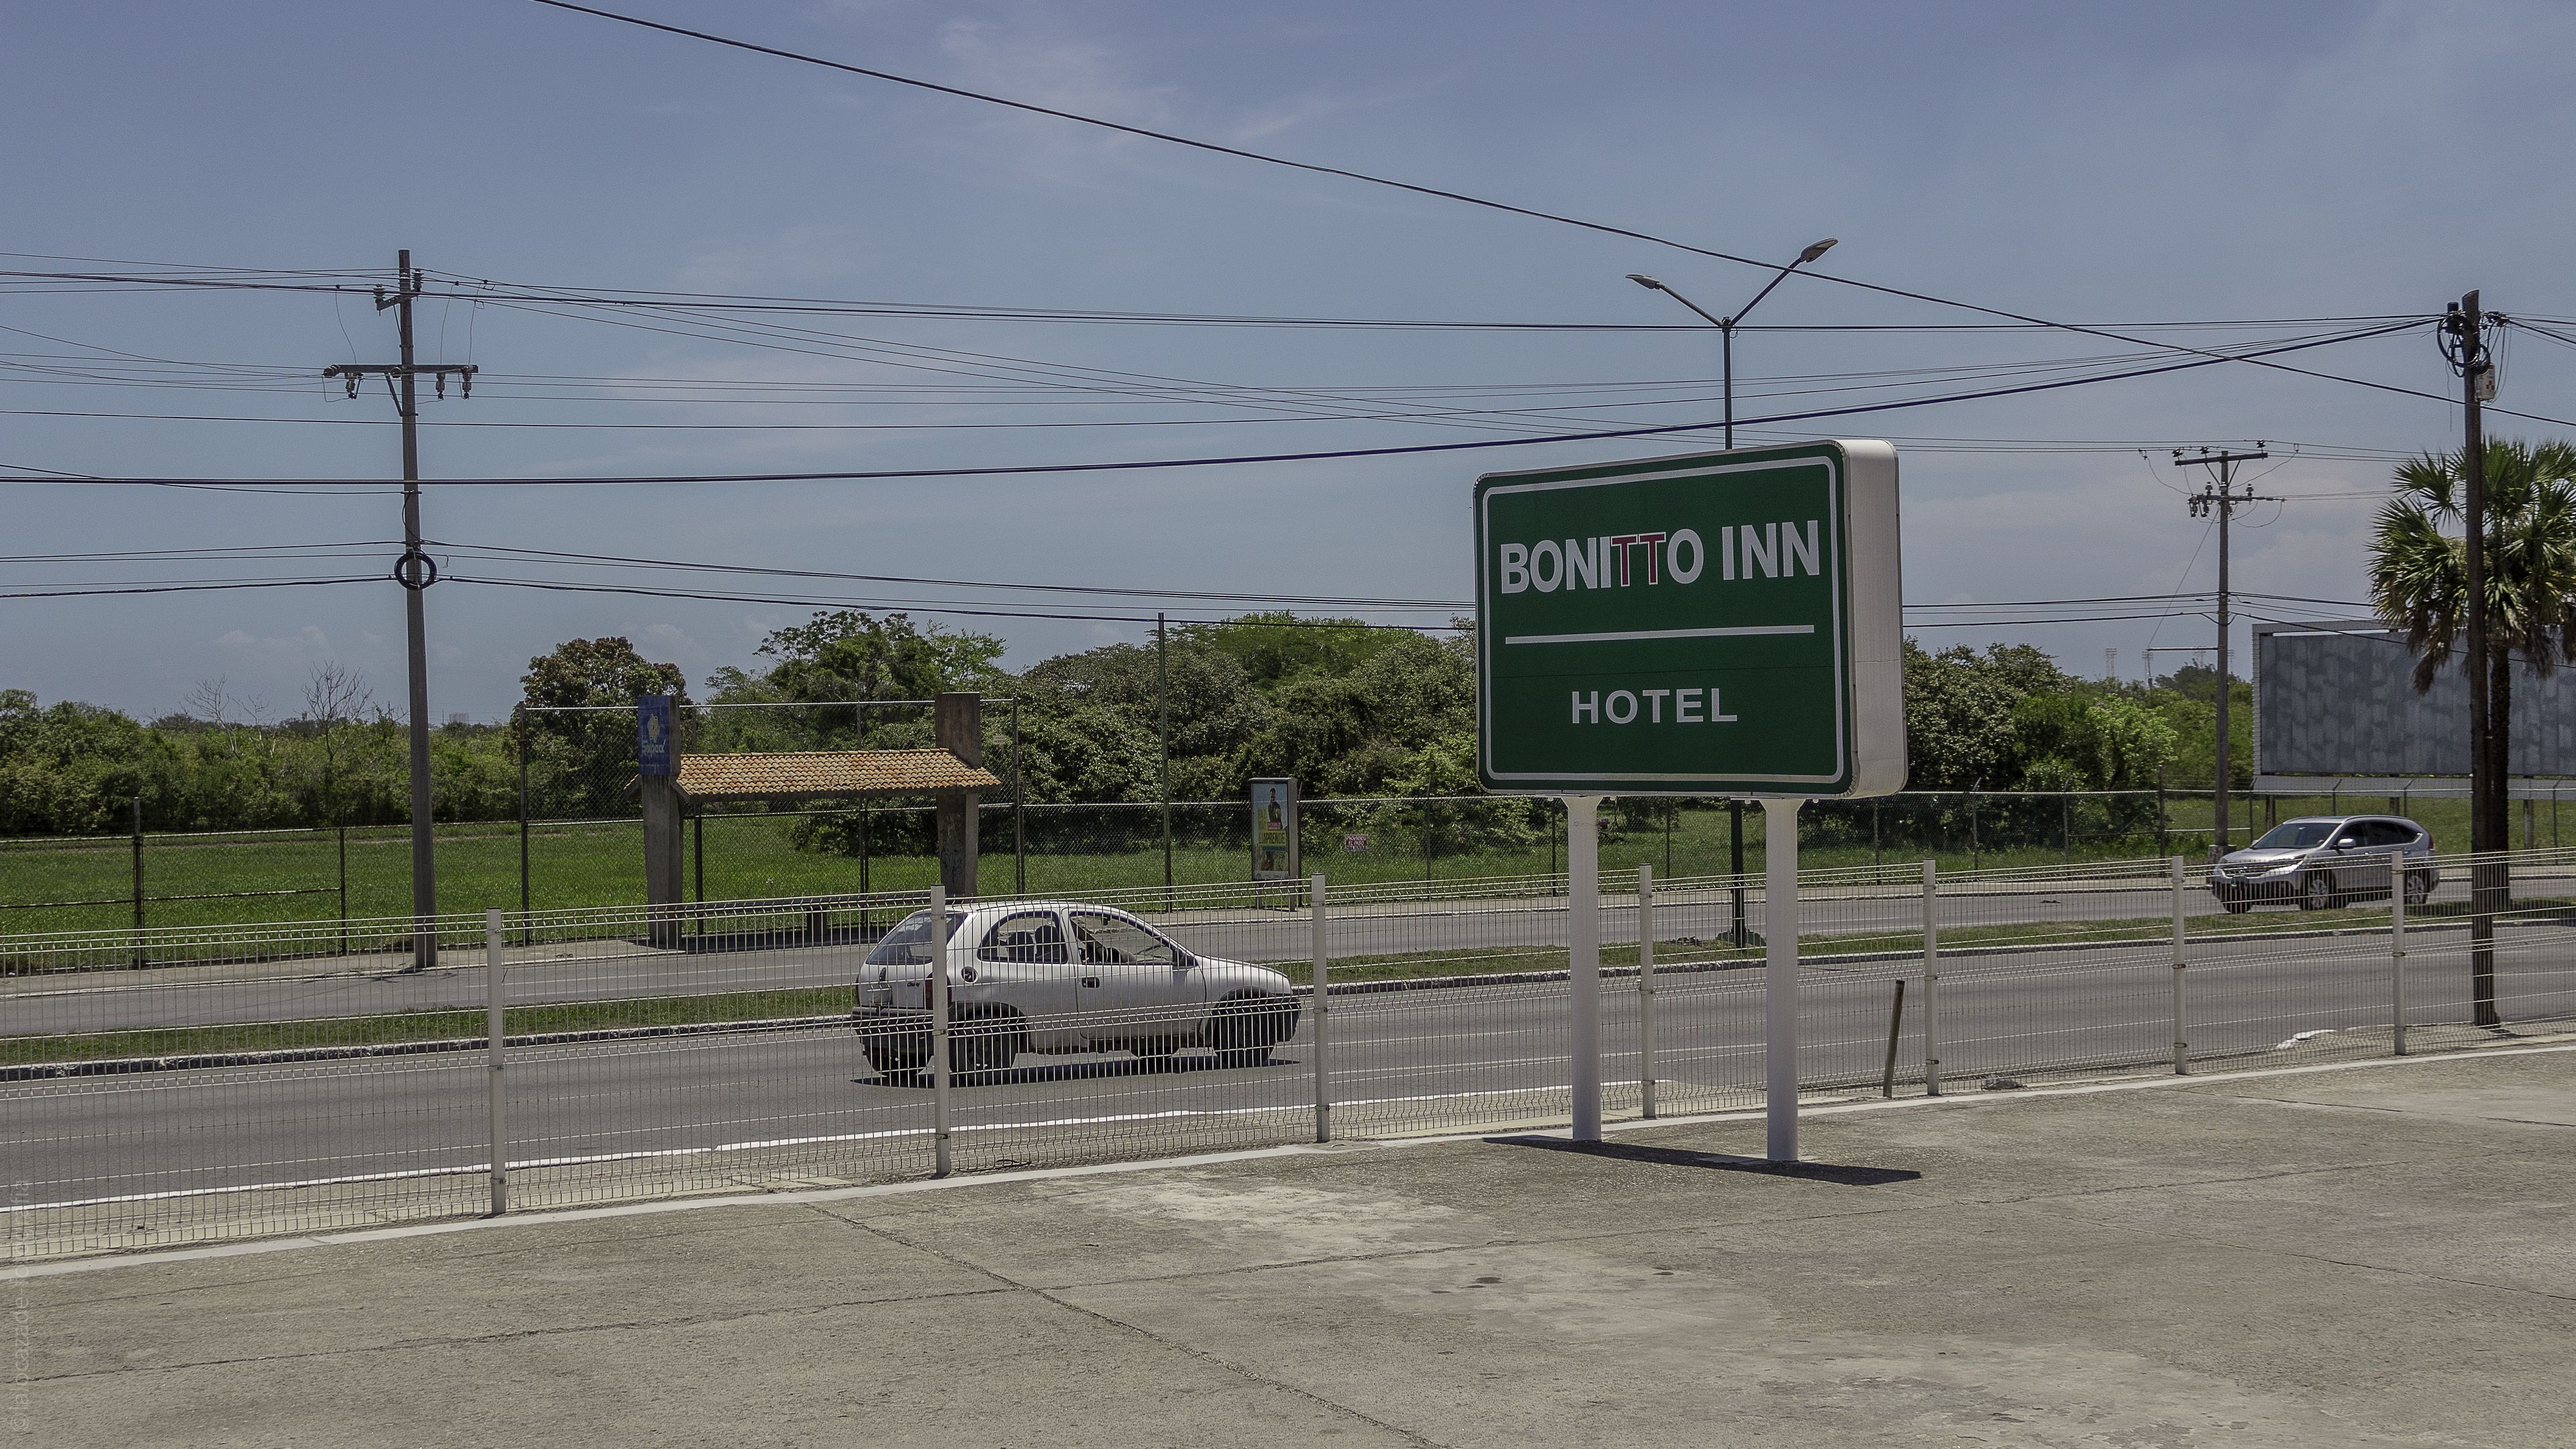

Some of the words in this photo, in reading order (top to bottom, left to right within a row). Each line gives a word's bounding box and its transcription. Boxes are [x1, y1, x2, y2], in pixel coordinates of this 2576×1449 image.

[1500, 529, 1704, 594] BONITTO
[1722, 520, 1820, 580] INN
[1571, 688, 1738, 724] HOTEL
